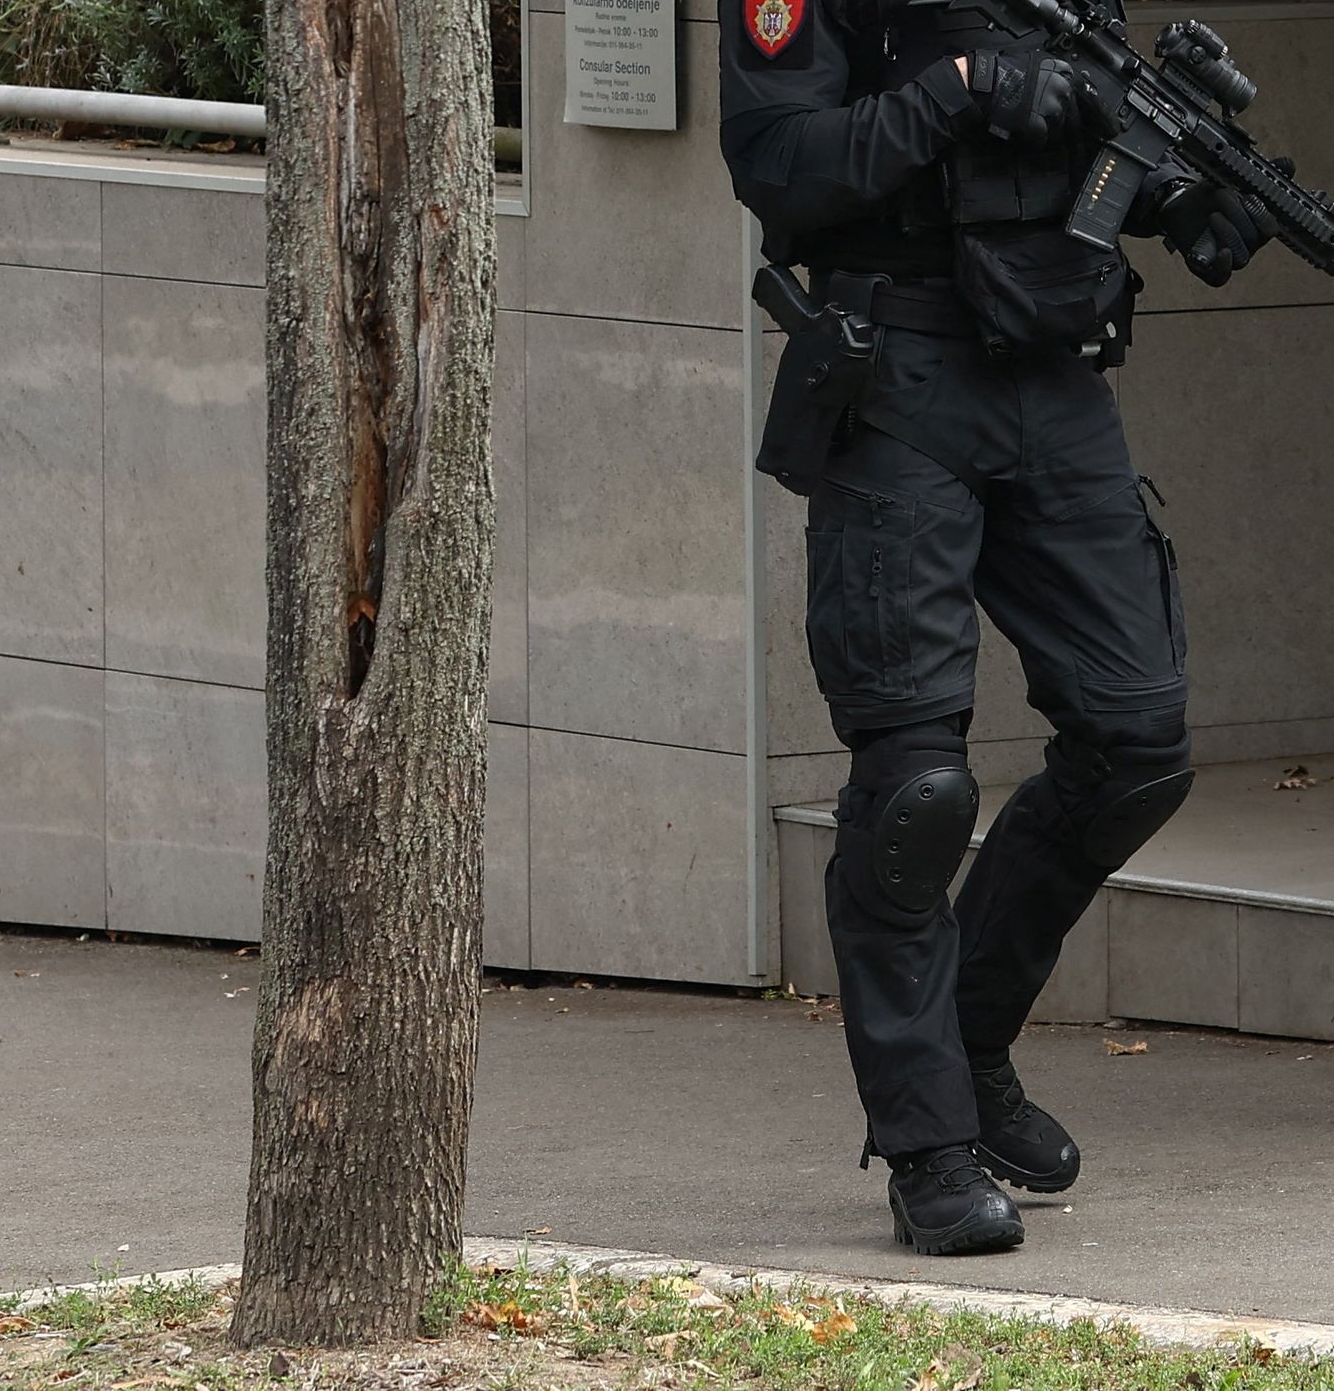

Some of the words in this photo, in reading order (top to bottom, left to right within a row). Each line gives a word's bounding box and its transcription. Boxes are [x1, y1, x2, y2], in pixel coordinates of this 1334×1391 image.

[613, 26, 631, 37] 10:00
[638, 28, 658, 38] 13:00
[580, 58, 613, 73] Consular
[615, 61, 650, 75] Section
[611, 91, 629, 101] 10:00
[636, 93, 656, 103] 13:00
